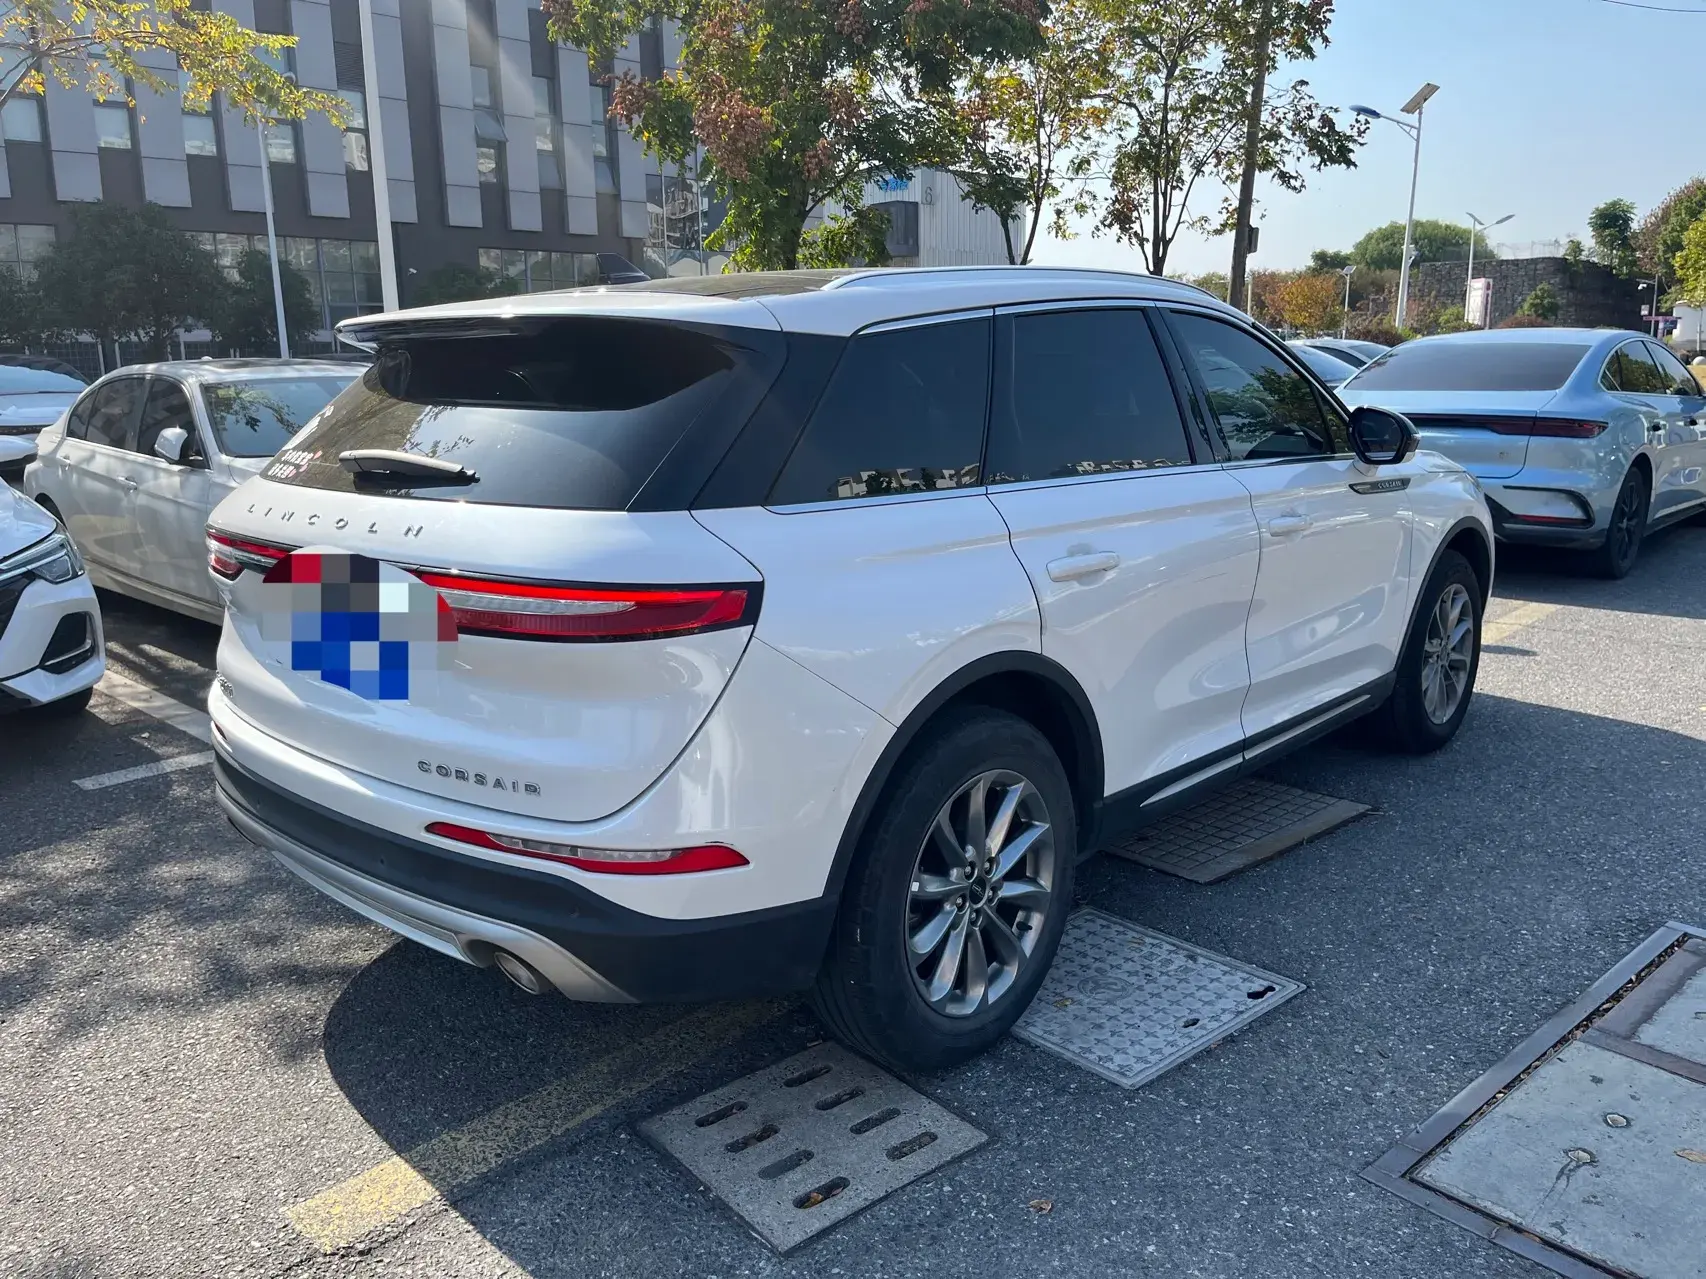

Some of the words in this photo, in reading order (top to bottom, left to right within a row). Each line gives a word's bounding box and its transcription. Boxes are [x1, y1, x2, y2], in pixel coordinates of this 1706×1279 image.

[925, 186, 933, 204] 6
[246, 503, 424, 539] LINCOLN
[417, 759, 542, 797] CORSAIR
